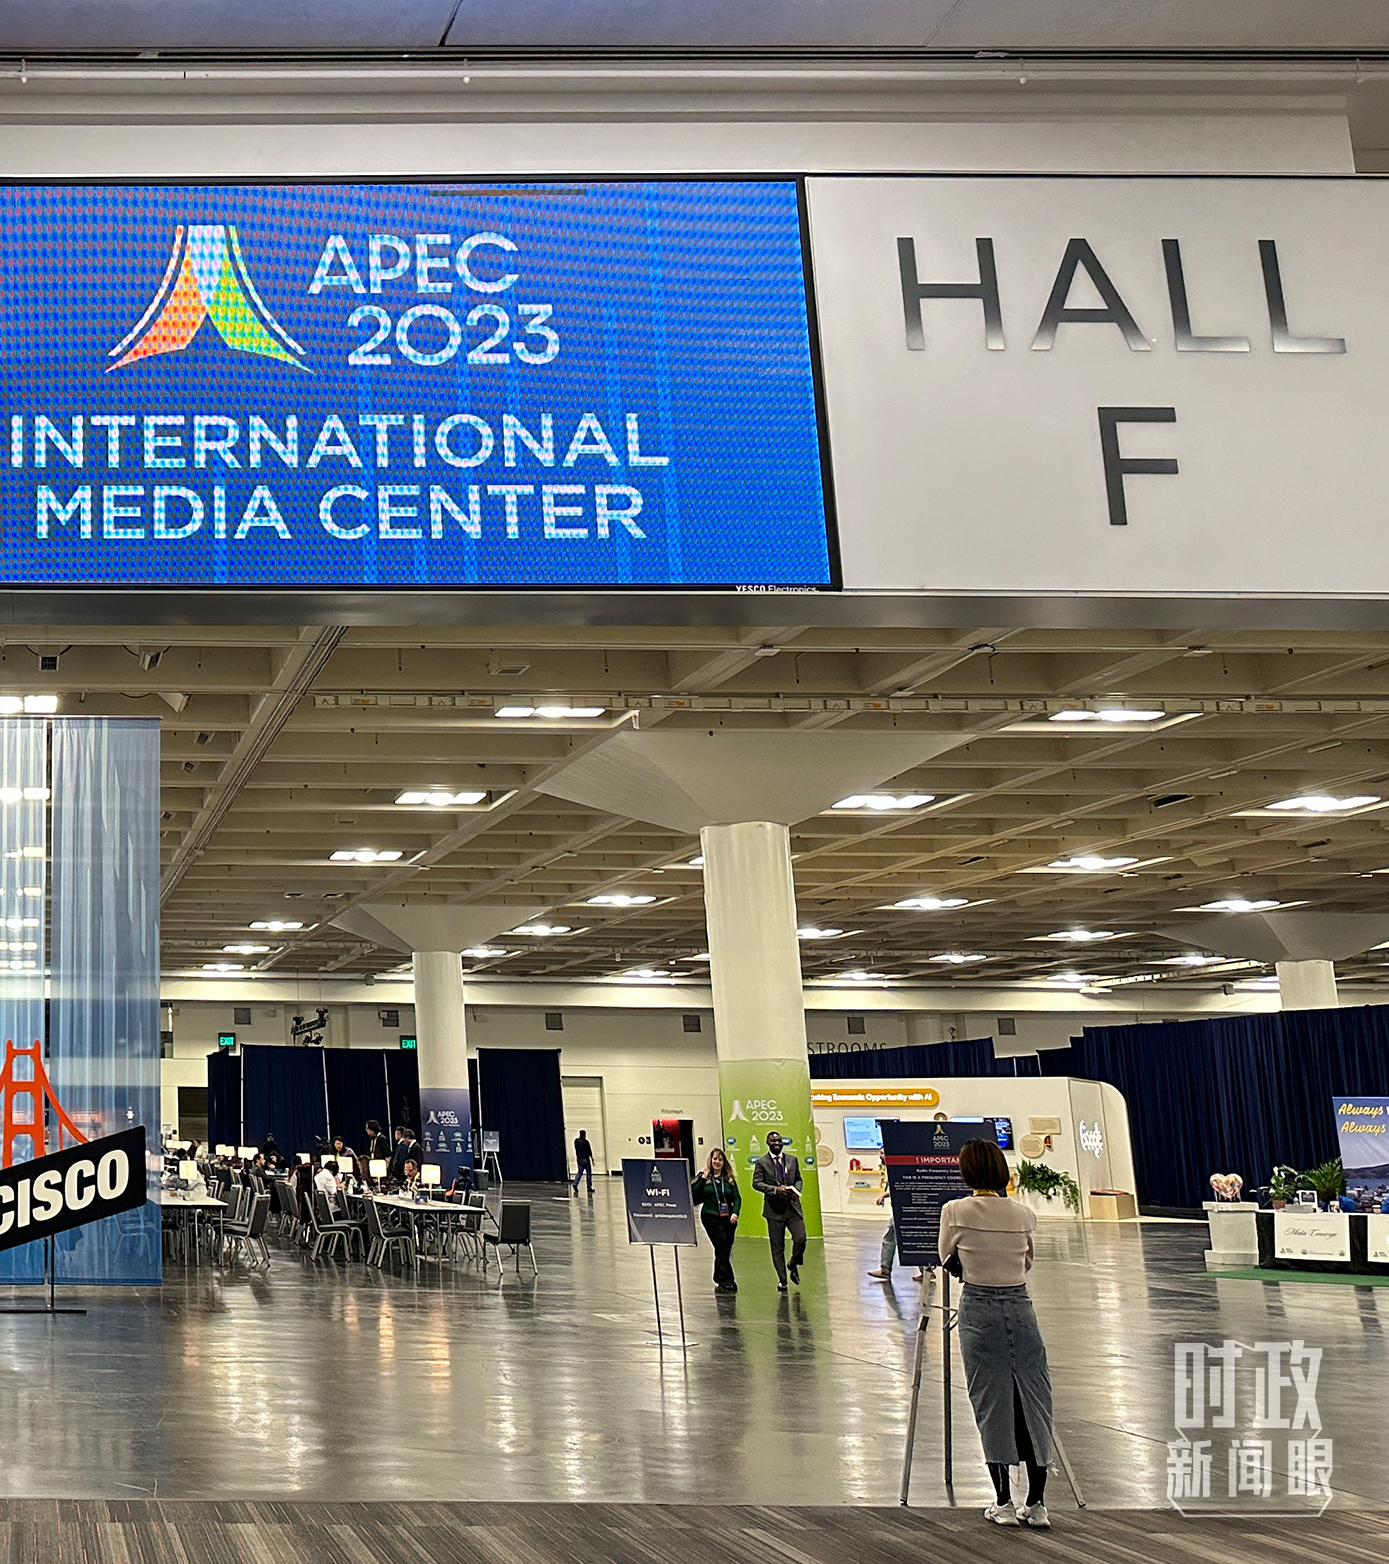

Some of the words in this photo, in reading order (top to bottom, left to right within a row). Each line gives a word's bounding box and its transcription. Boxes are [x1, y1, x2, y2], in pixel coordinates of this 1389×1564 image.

[307, 231, 520, 295] APEC
[896, 236, 1348, 354] HALL
[346, 303, 561, 366] 2023
[10, 411, 670, 469] INTERNATIONAL
[1097, 406, 1180, 527] F
[36, 484, 293, 540] MEDIA
[318, 484, 647, 540] CENTER
[220, 1036, 234, 1045] EXIT
[746, 1100, 777, 1110] APEC
[865, 1093, 907, 1103] Opportunity
[1338, 1103, 1383, 1118] Always
[752, 1111, 783, 1121] 2023
[1341, 1121, 1386, 1136] Always
